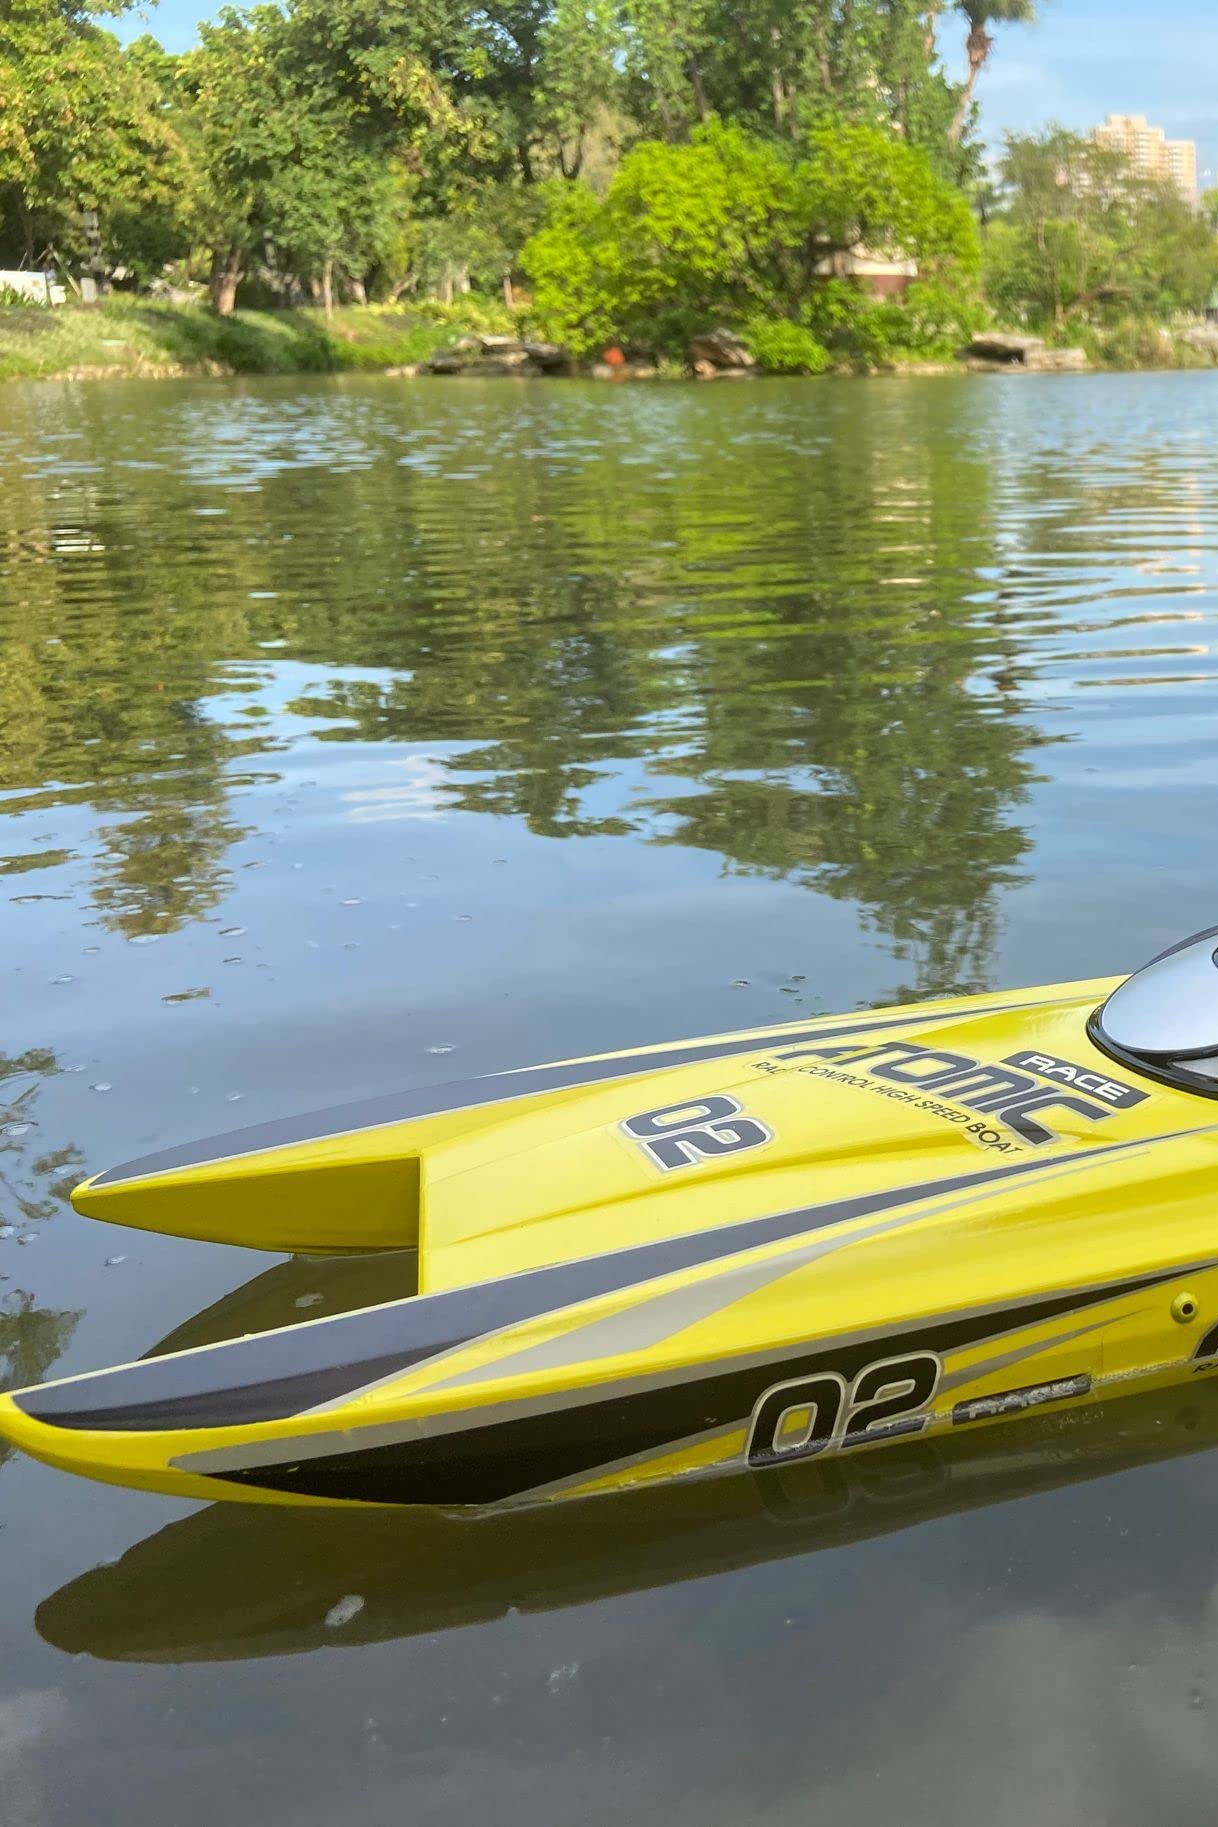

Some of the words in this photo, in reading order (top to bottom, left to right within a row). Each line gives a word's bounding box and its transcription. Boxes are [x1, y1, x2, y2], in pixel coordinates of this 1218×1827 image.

[774, 1041, 1113, 1146] ATOMIC
[797, 1066, 873, 1090] CONTROL
[871, 1085, 918, 1104] HIGH
[914, 1099, 971, 1124] SPEED
[965, 1122, 1024, 1155] BOAT
[1019, 1055, 1131, 1101] RACE
[619, 1095, 773, 1171] 02
[746, 1352, 940, 1467] 02
